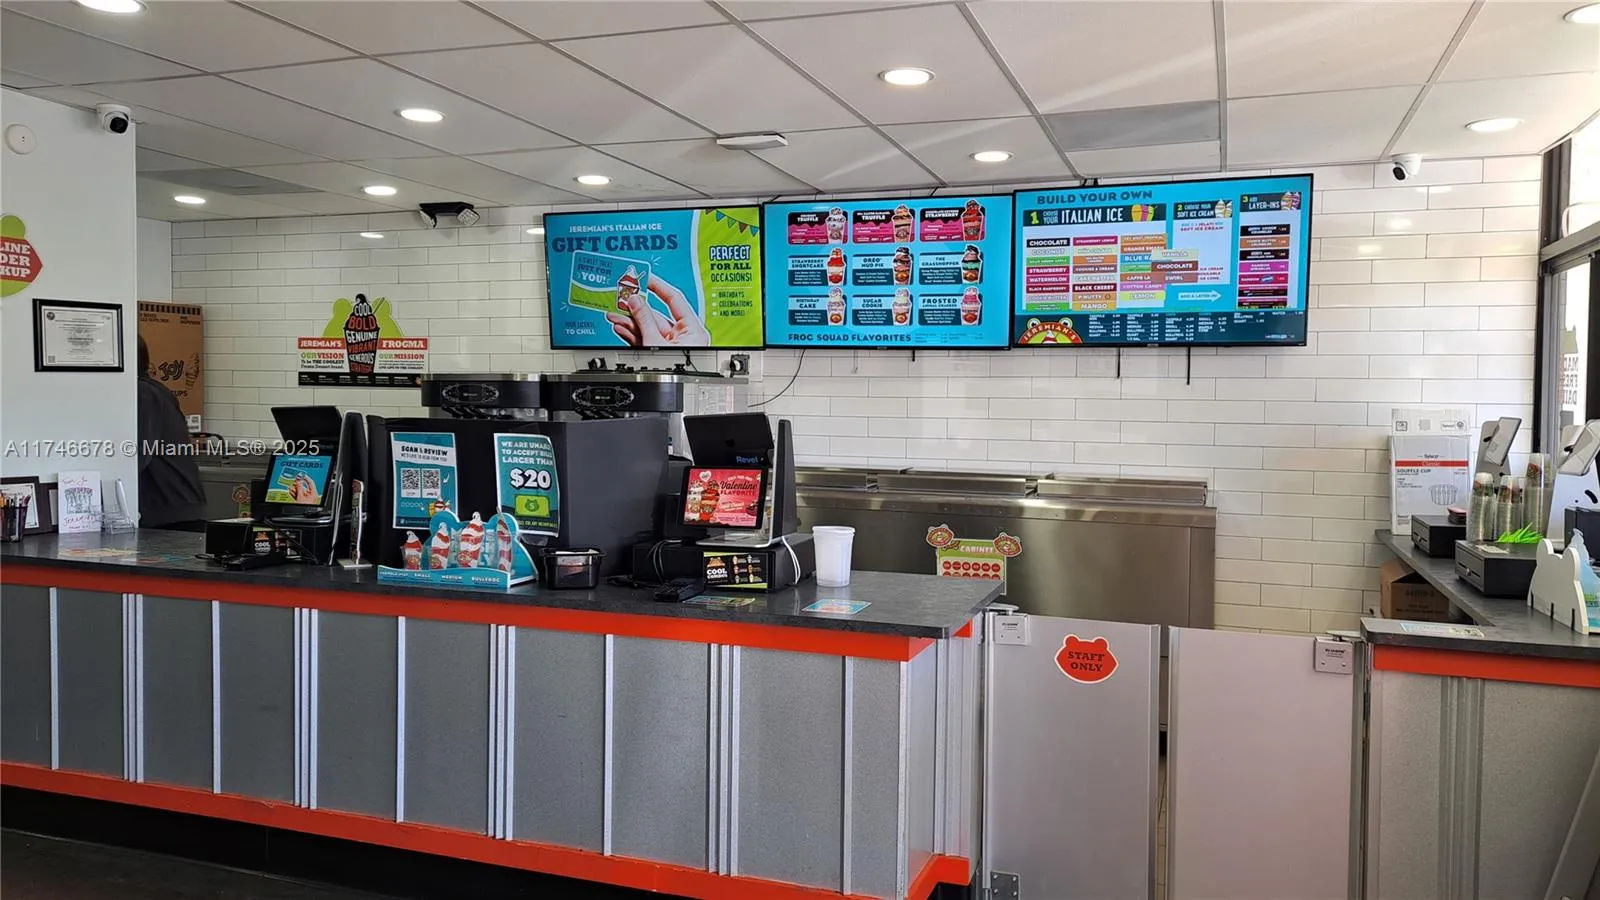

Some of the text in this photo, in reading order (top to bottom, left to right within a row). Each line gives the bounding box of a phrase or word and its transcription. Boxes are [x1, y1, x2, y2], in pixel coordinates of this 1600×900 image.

[1037, 190, 1152, 204] BUILD YOUR OWN
[1030, 212, 1039, 224] 1
[1044, 216, 1058, 224] YOUR
[1062, 208, 1123, 223] ITALIAN ICE
[569, 225, 614, 233] JEREMIAH'S
[616, 224, 648, 232] ITALIAN
[552, 234, 678, 252] GIFT CARDS
[710, 246, 751, 260] PERFECT
[582, 272, 606, 284] YOU!
[711, 272, 752, 282] OCCASIONS!
[354, 302, 372, 316] COOL
[348, 316, 377, 330] BOLD
[346, 331, 378, 343] GENUINE
[788, 334, 813, 342] FROG
[816, 334, 849, 342] SQUAD
[852, 334, 912, 342] FLAVORITES
[1024, 324, 1076, 340] JEREMIAH'S
[348, 341, 376, 353] VIBRANT
[736, 456, 758, 464] Revel
[510, 468, 551, 489] $20
[720, 481, 758, 490] Valentine
[1068, 651, 1104, 661] STAFF
[1070, 662, 1103, 672] ONLY
